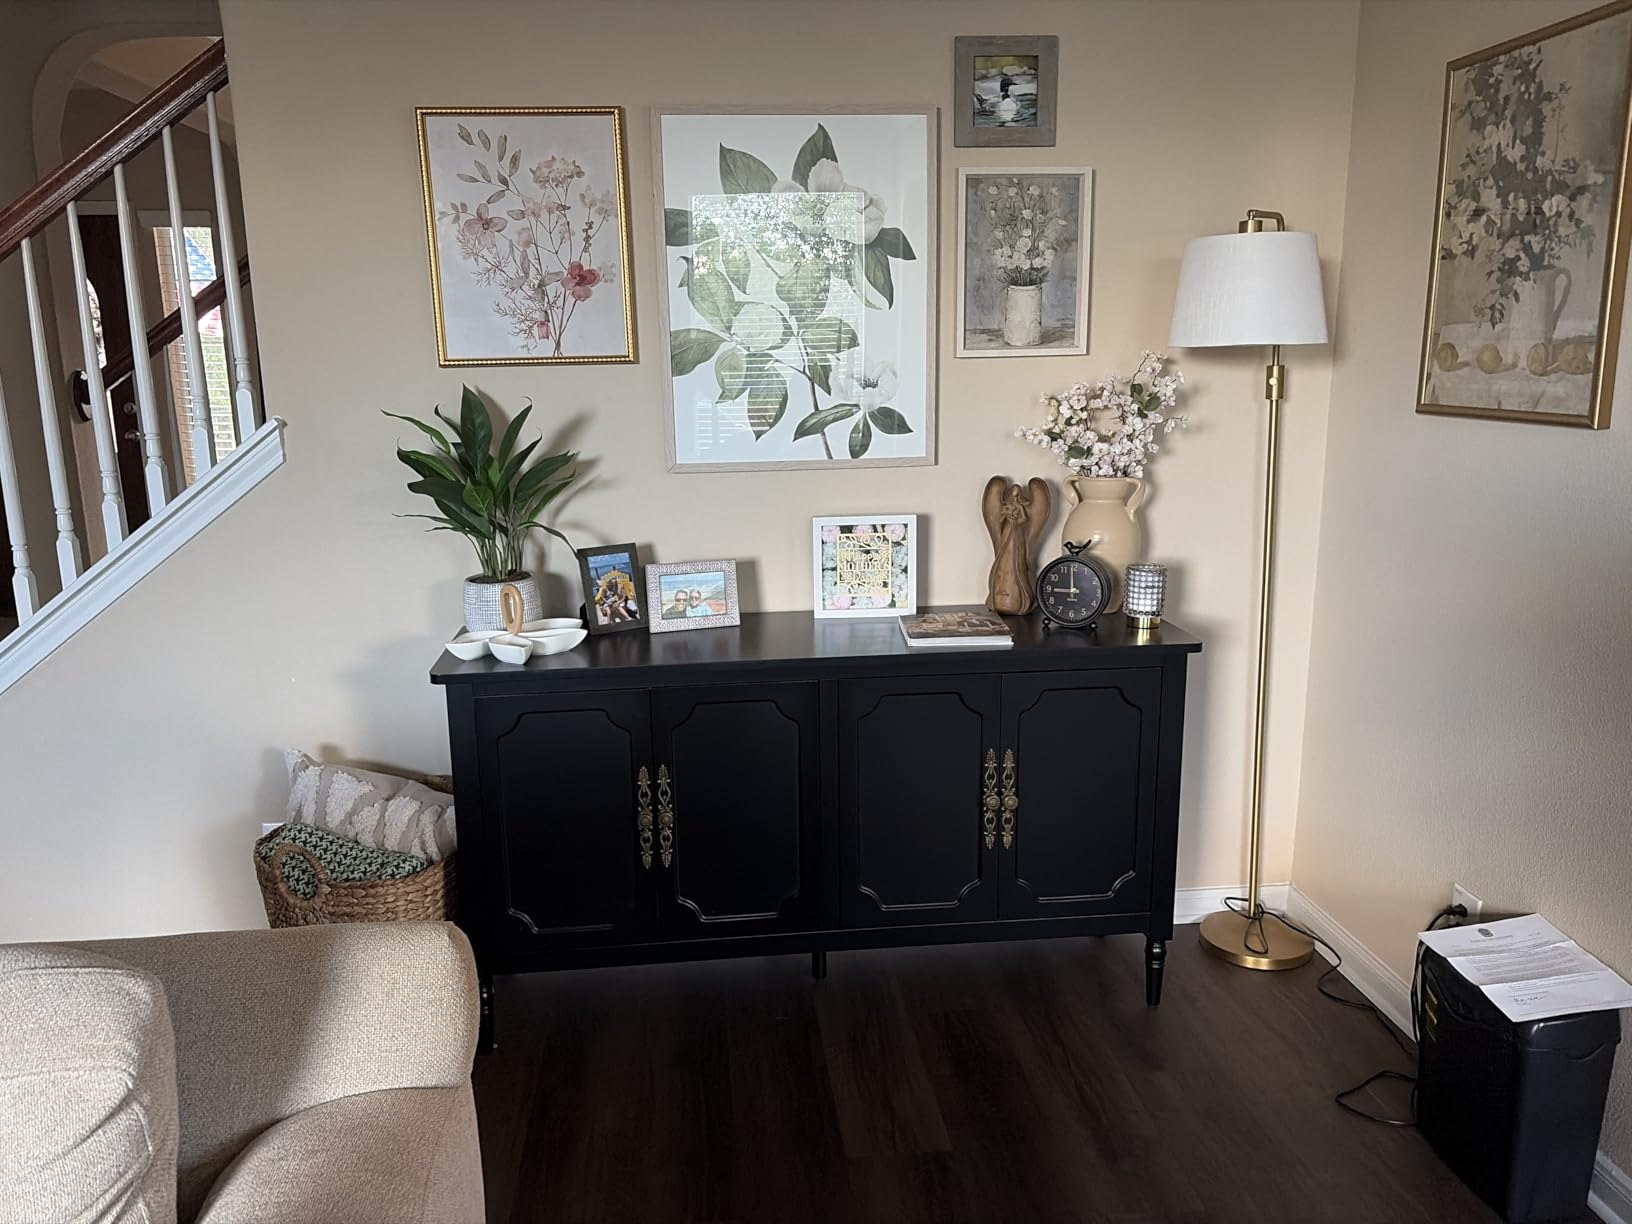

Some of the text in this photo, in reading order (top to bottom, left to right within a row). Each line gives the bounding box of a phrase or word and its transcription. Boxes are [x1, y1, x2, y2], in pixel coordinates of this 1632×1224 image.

[1061, 566, 1067, 574] 11
[1071, 564, 1079, 572] 12
[1050, 574, 1059, 582] 10
[1092, 577, 1098, 585] 2
[1095, 589, 1101, 597] 3
[1049, 596, 1055, 604] 8
[1057, 605, 1063, 613] 7
[1081, 608, 1087, 616] 5
[1069, 610, 1075, 618] 6
